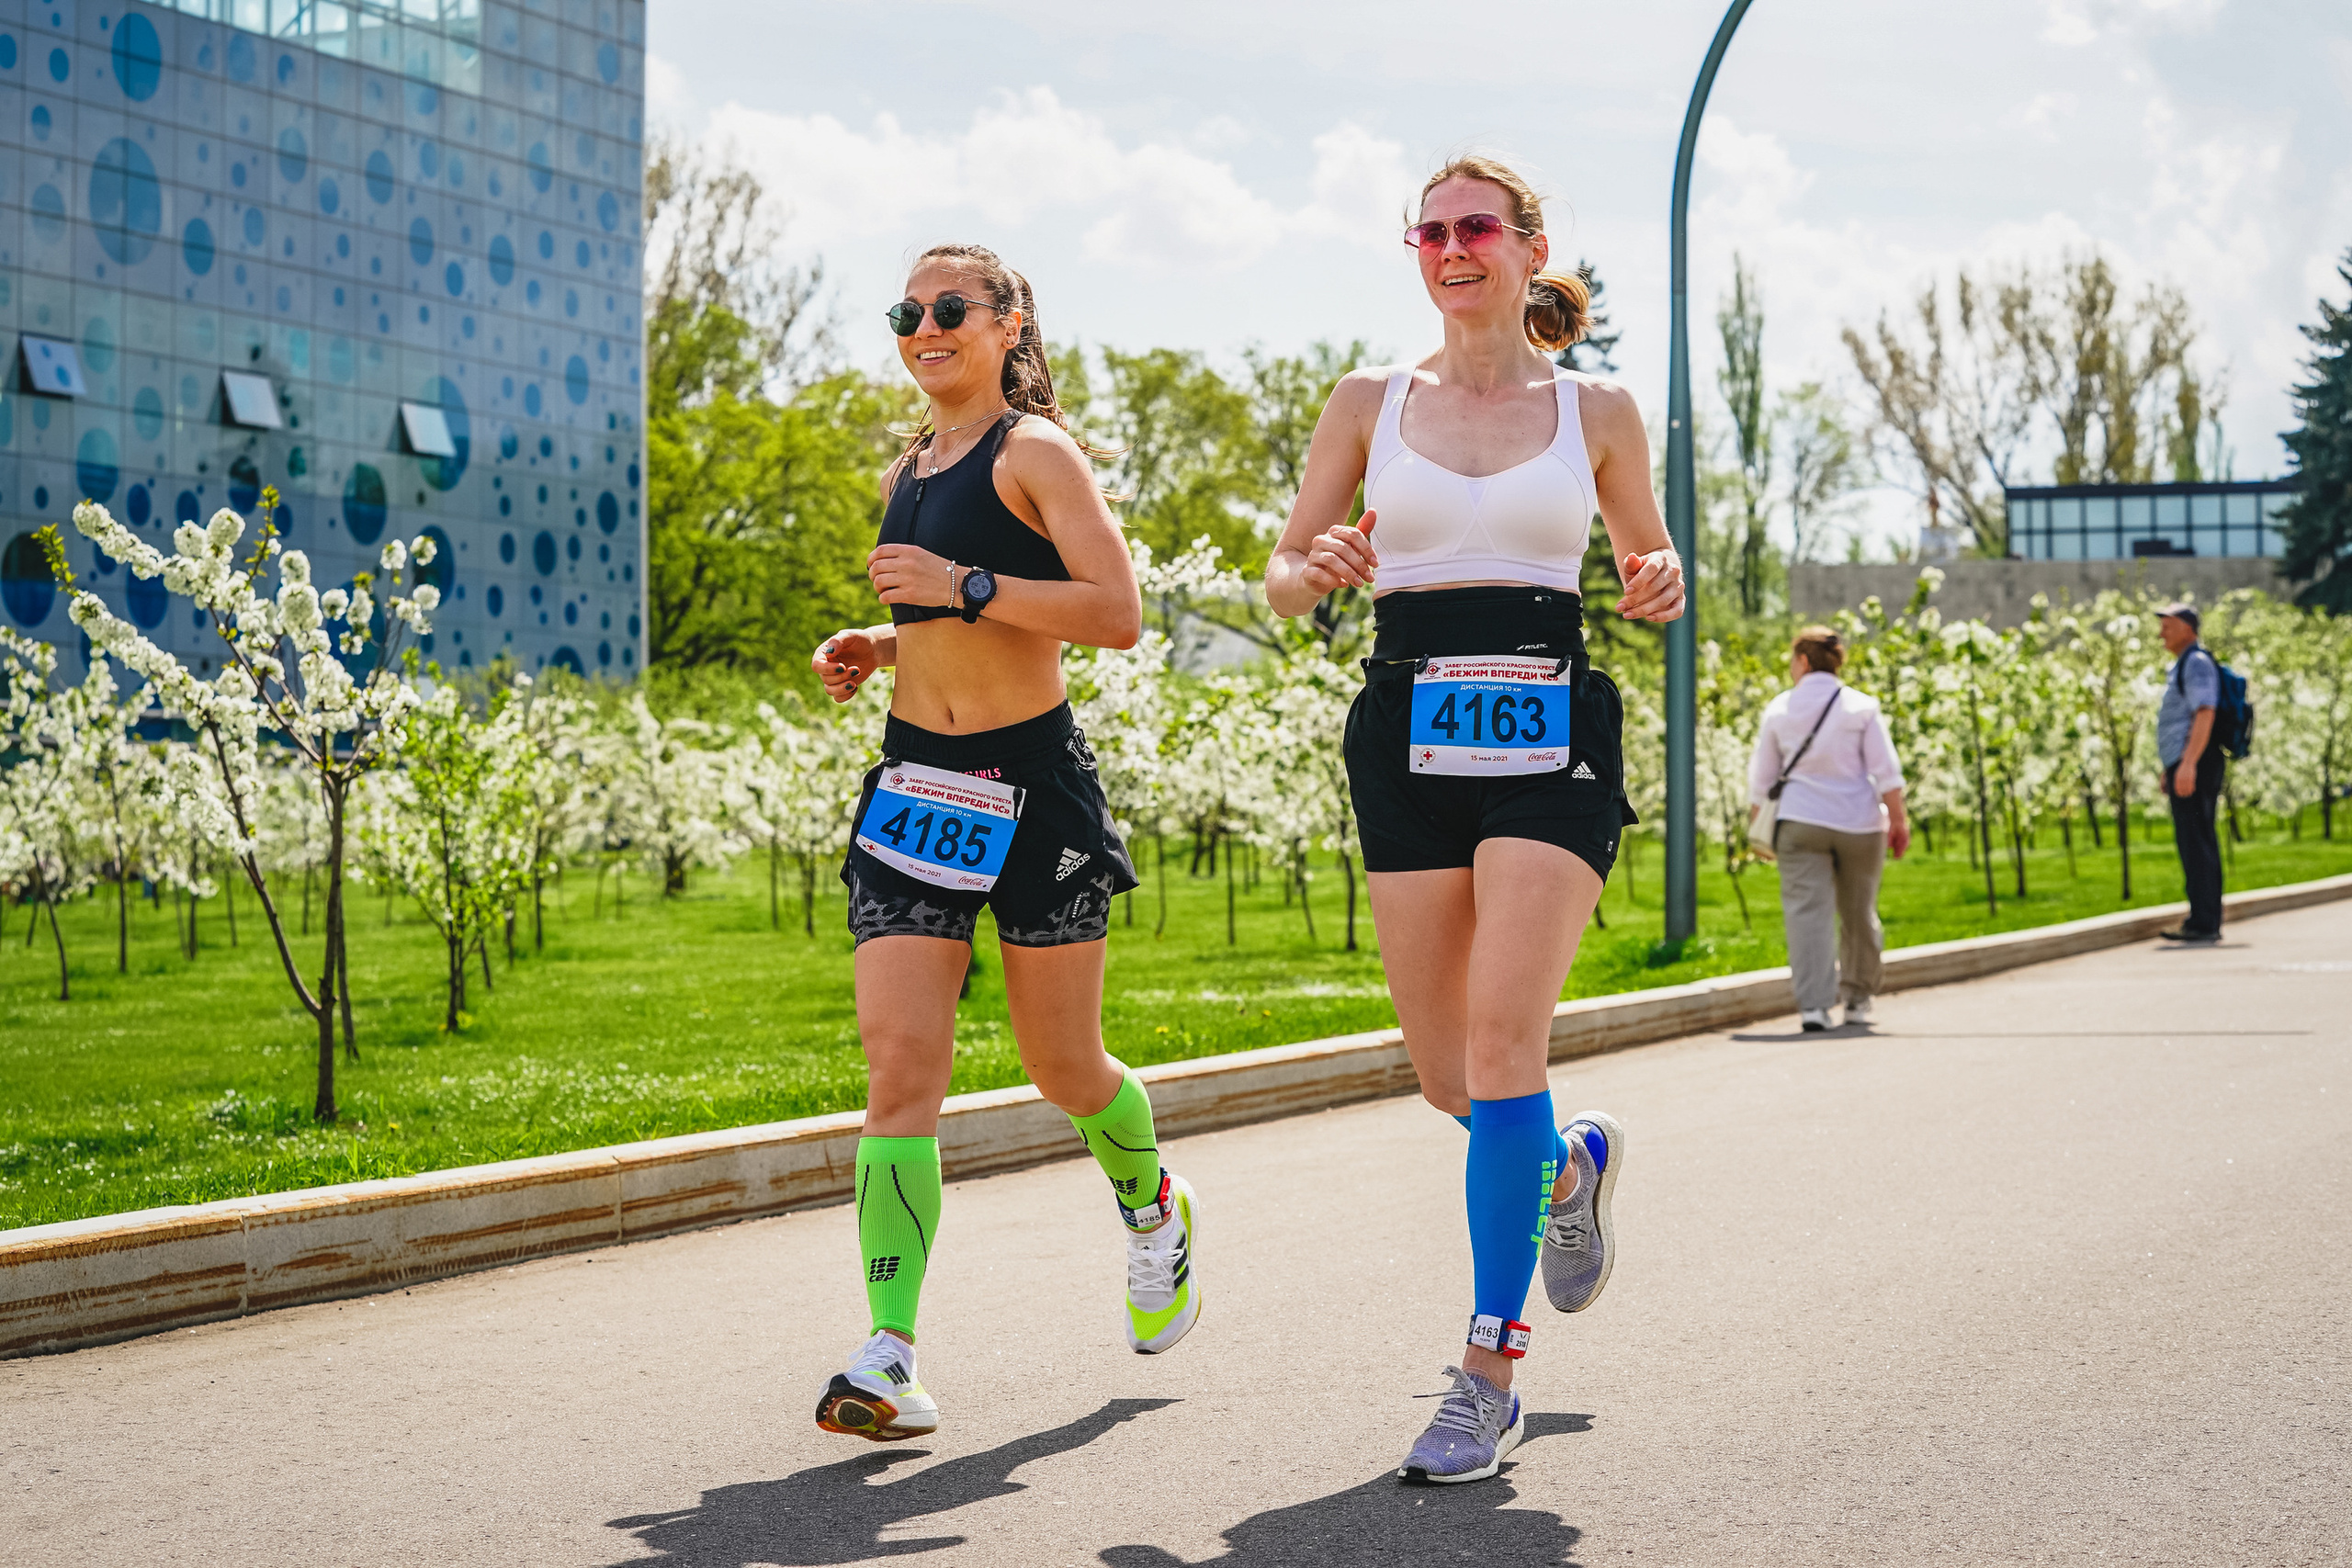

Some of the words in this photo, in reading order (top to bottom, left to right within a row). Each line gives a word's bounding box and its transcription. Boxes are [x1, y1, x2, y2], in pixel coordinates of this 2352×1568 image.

[1443, 670, 1488, 678] «БЕЖИМ
[1490, 670, 1538, 680] ВПЕРЕДИ
[1431, 693, 1547, 743] 4163
[925, 780, 961, 793] РОССИЙСКОГО
[963, 788, 991, 799] КРАСНОГО
[992, 795, 1012, 805] КРЕСТА
[905, 786, 944, 799] «БЕЖИМ
[946, 794, 990, 810] ВПЕРЕДИ
[992, 804, 1010, 815] ЧС»
[916, 801, 955, 814] ДИСТАНЦИЯ
[880, 807, 992, 867] 4185
[915, 865, 926, 874] мая
[927, 868, 941, 878] 2021
[1055, 853, 1091, 881] adidas
[1138, 1214, 1160, 1223] 4185
[869, 1273, 895, 1282] cep
[1474, 1325, 1498, 1338] 4163
